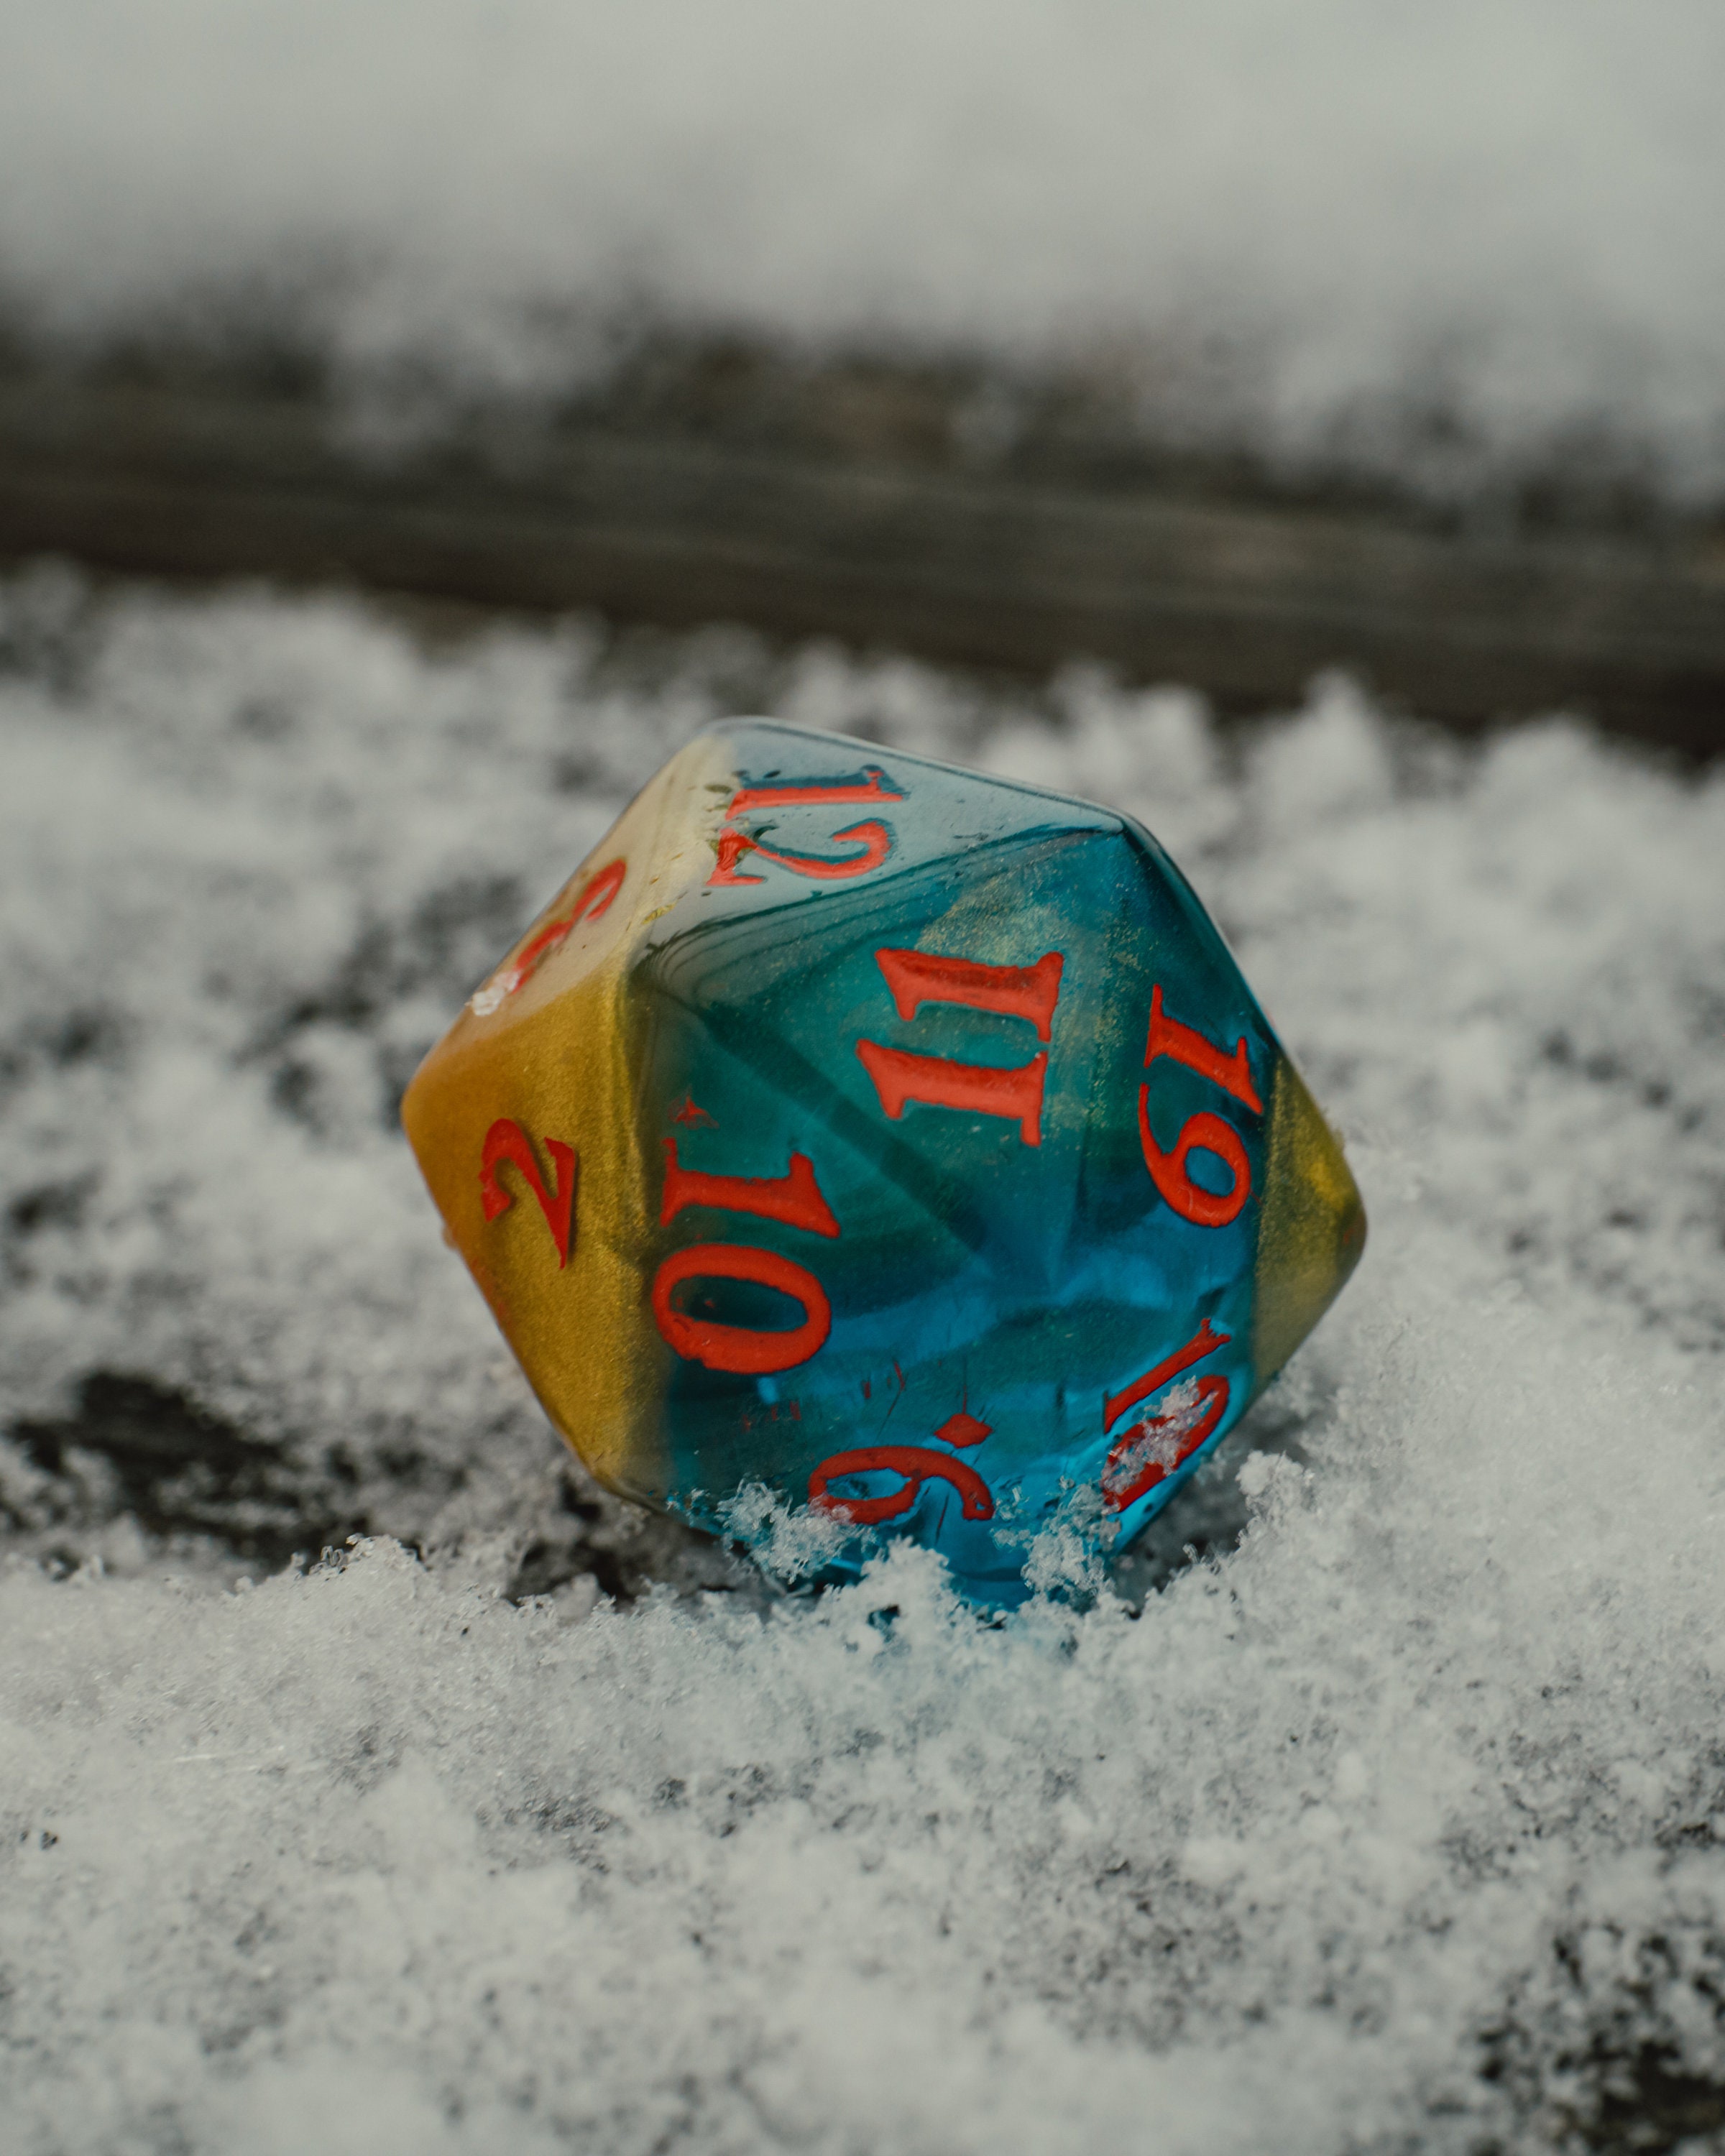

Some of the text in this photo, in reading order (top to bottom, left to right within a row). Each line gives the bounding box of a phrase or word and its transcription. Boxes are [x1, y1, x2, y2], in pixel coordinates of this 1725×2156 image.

[707, 769, 904, 887] 12
[855, 947, 1064, 1148] 11
[1137, 983, 1264, 1228] 19
[478, 1118, 576, 1270] 2
[652, 1137, 841, 1374] 10
